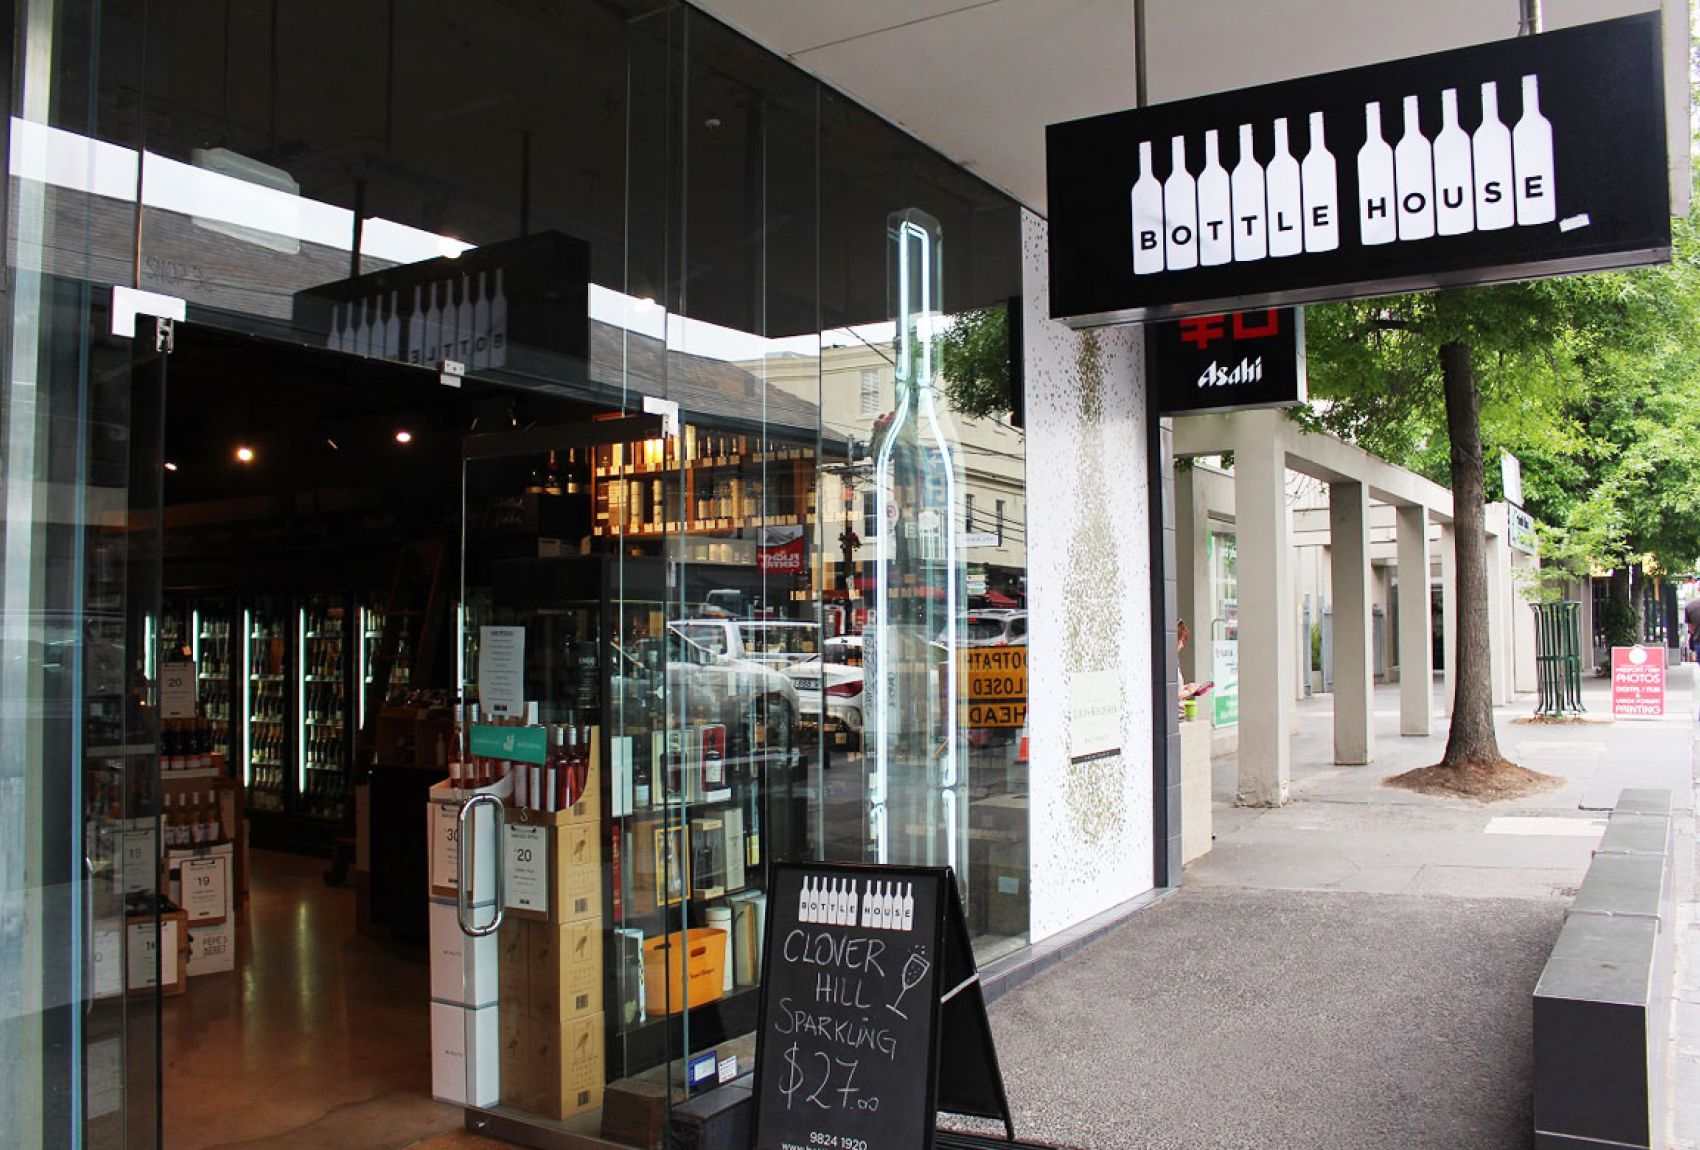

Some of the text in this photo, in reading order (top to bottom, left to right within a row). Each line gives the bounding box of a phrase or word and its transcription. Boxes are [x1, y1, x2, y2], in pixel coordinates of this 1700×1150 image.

[1140, 175, 1543, 251] BOTTLE HOUSE
[1197, 355, 1263, 388] Asahi
[1615, 673, 1661, 683] PHOTOS
[1615, 704, 1661, 714] PRINTING
[801, 901, 911, 918] BOTTLE HOUSE
[783, 929, 885, 977] CLOVER
[815, 972, 872, 1008] HILL
[809, 1131, 838, 1148] 9824
[840, 1136, 868, 1150] 1920
